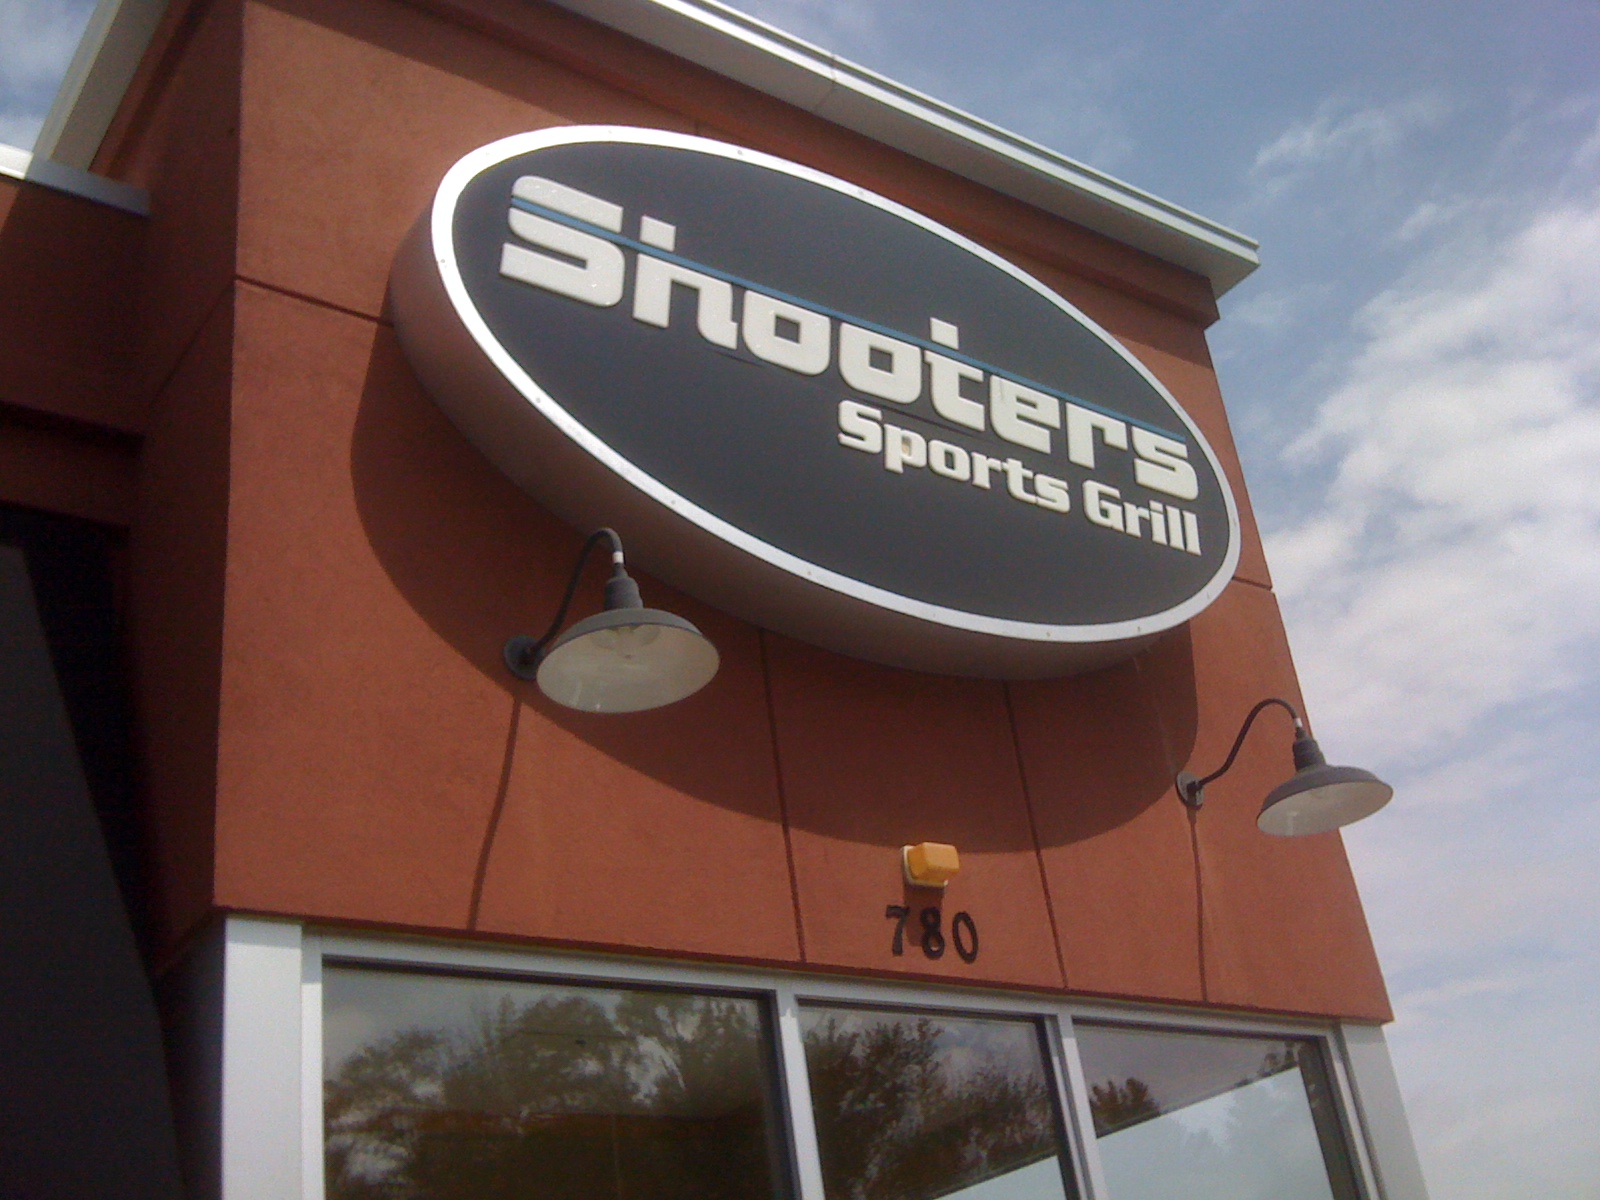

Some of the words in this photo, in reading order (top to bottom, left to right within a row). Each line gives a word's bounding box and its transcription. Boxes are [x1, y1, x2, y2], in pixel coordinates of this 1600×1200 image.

[500, 175, 1199, 500] Shooters
[838, 399, 1071, 513] Sports
[1082, 479, 1202, 556] Grill
[885, 904, 979, 964] 780
